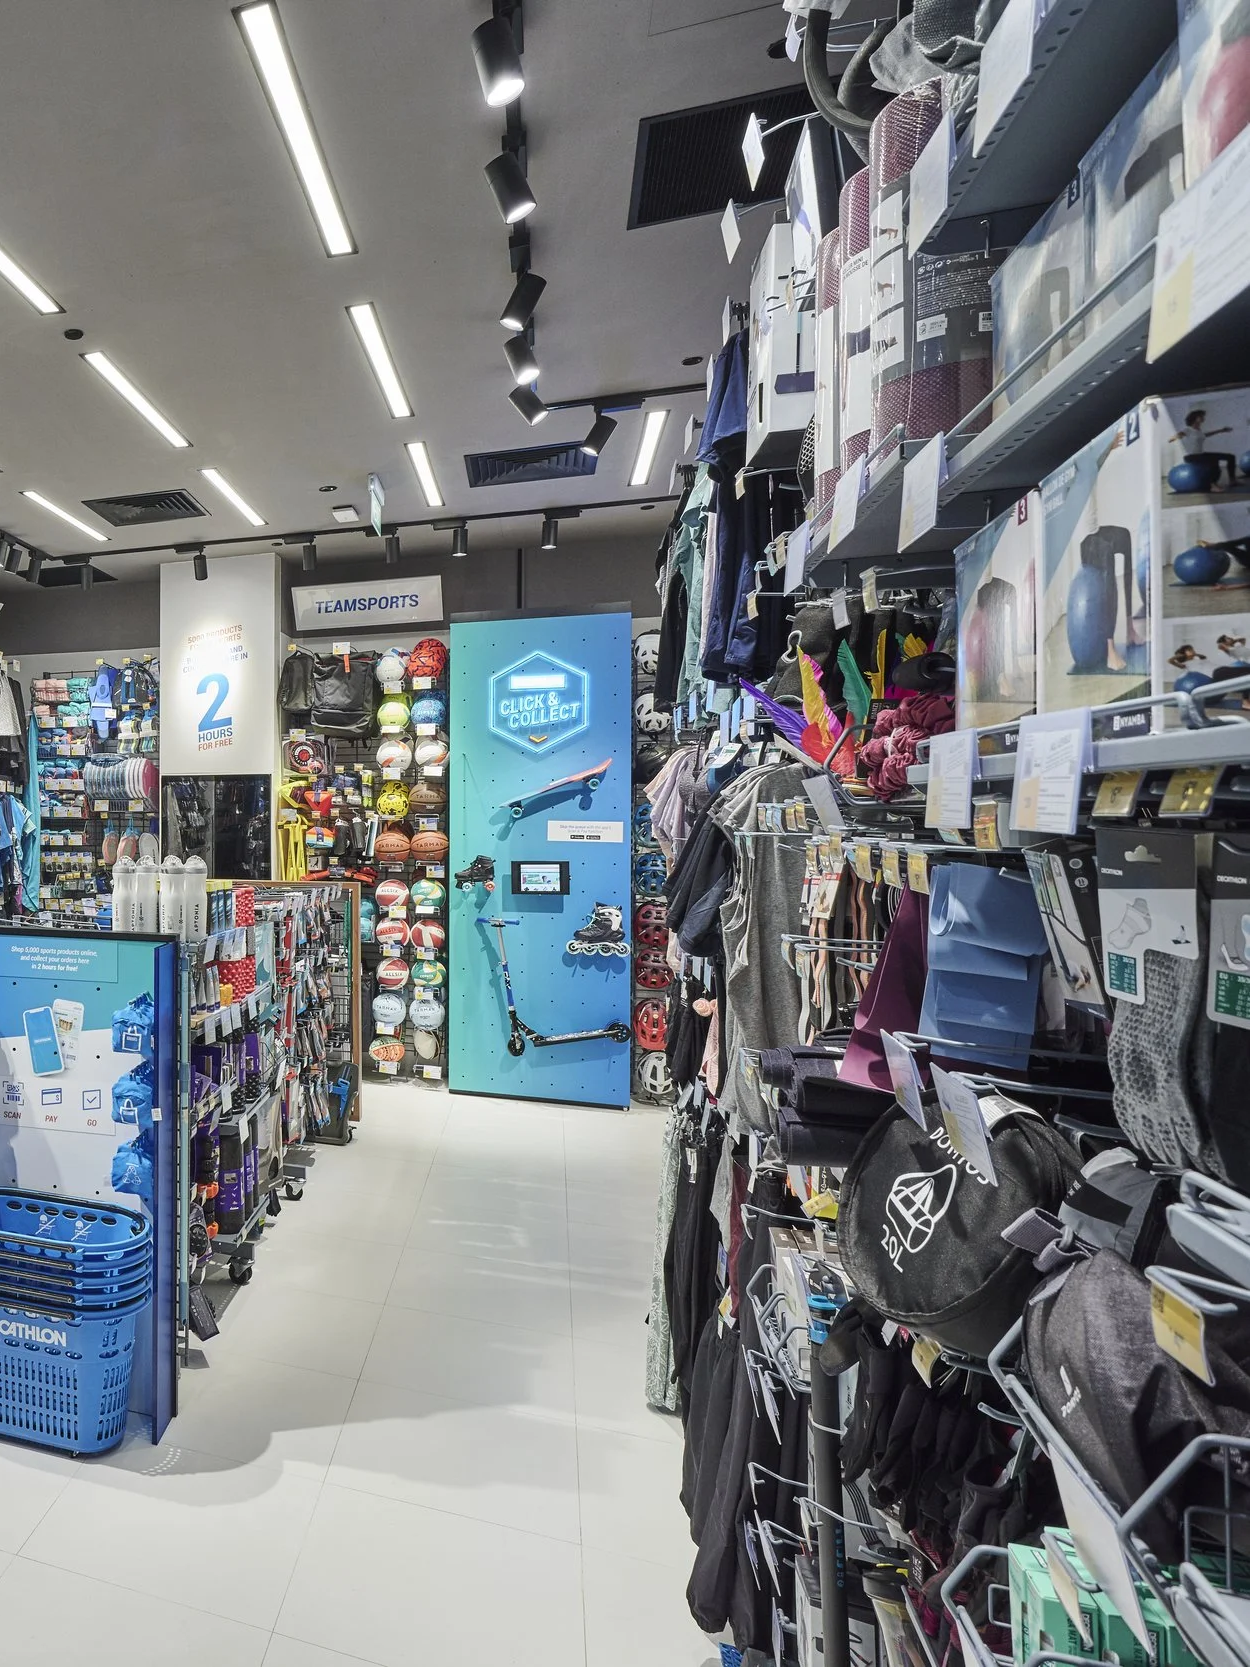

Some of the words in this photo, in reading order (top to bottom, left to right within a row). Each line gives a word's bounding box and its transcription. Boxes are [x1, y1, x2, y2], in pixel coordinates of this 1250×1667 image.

[1128, 413, 1138, 440] 2
[1019, 498, 1027, 521] 3
[315, 594, 419, 614] TEAMSPORTS
[240, 651, 248, 661] IN
[197, 672, 232, 733] 2
[500, 693, 543, 716] CLICK
[548, 691, 559, 706] &
[509, 702, 580, 729] COLLECT
[1119, 713, 1147, 728] NYAMBA
[198, 727, 233, 743] HOURS
[198, 740, 213, 752] FOR
[214, 738, 233, 750] FREE
[11, 945, 24, 953] Shop
[40, 947, 56, 955] sports
[56, 948, 80, 956] products
[65, 964, 79, 972] free!
[3, 1110, 22, 1120] SCAN
[44, 1114, 58, 1123] PAY
[87, 1118, 97, 1127] GO
[880, 1223, 904, 1274] 20L
